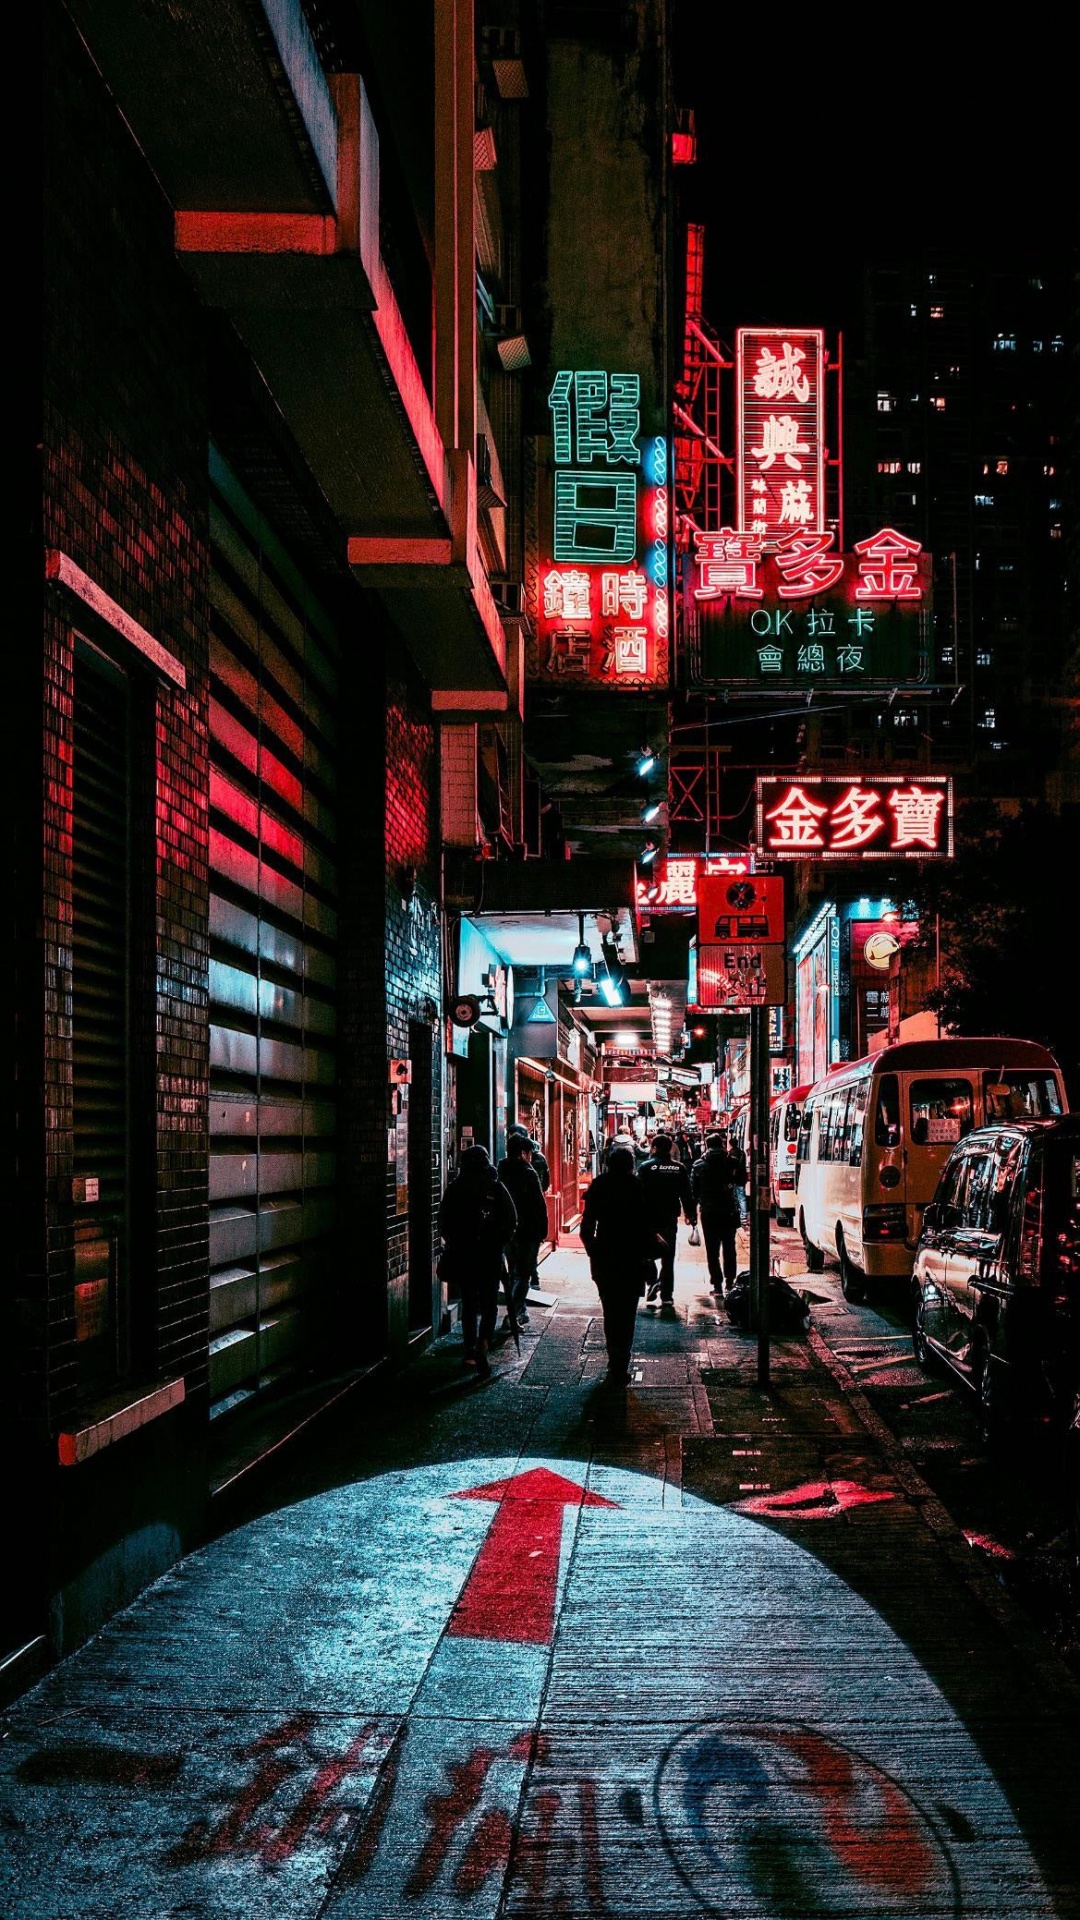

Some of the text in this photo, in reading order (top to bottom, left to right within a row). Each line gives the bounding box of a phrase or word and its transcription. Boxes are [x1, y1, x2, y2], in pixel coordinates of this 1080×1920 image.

[547, 370, 641, 564] 假日
[765, 786, 946, 850] 金多寶
[724, 952, 762, 969] End
